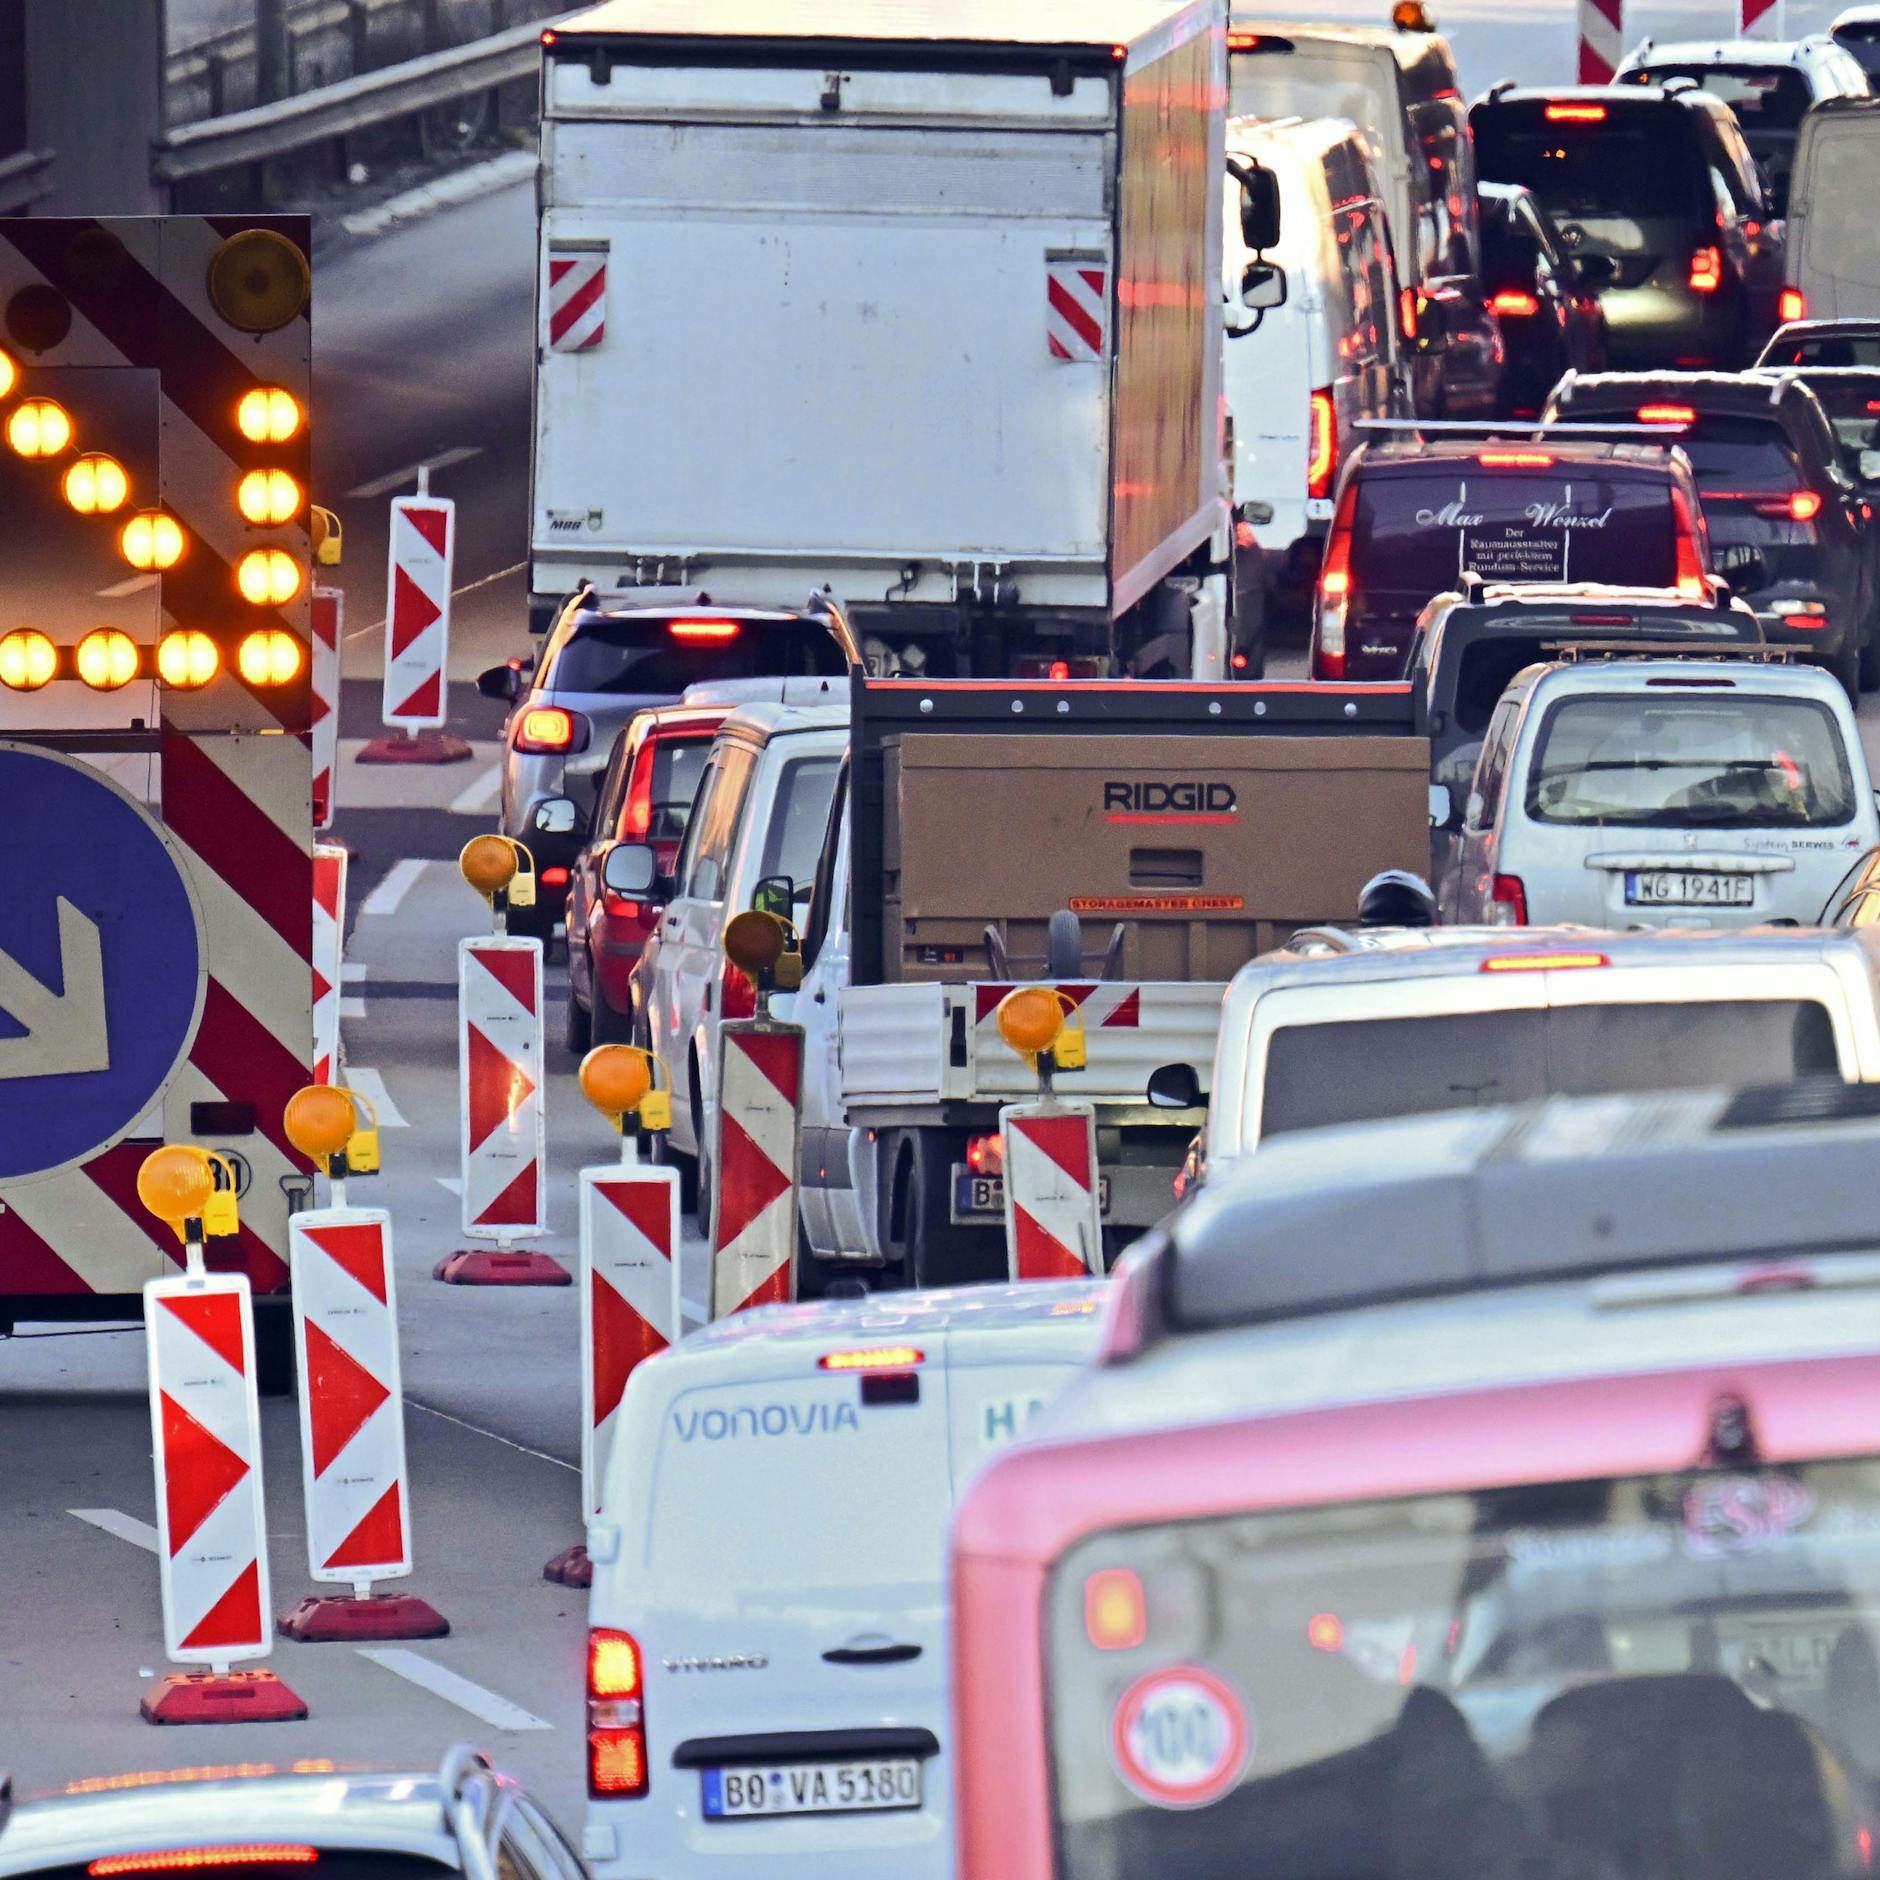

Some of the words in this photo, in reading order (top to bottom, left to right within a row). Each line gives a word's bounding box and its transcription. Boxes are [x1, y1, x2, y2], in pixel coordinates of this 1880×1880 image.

[1416, 502, 1484, 526] Max
[1505, 528, 1524, 537] Der
[1476, 551, 1493, 560] mit
[1104, 782, 1236, 811] RIDGID
[1792, 840, 1835, 850] SERWIS
[1641, 874, 1669, 899] WG
[1681, 877, 1747, 901] 1941F
[1072, 899, 1189, 909] STORAGEMASTER
[726, 1773, 765, 1809] BO
[790, 1770, 829, 1805] VA
[837, 1766, 915, 1802] 5180
